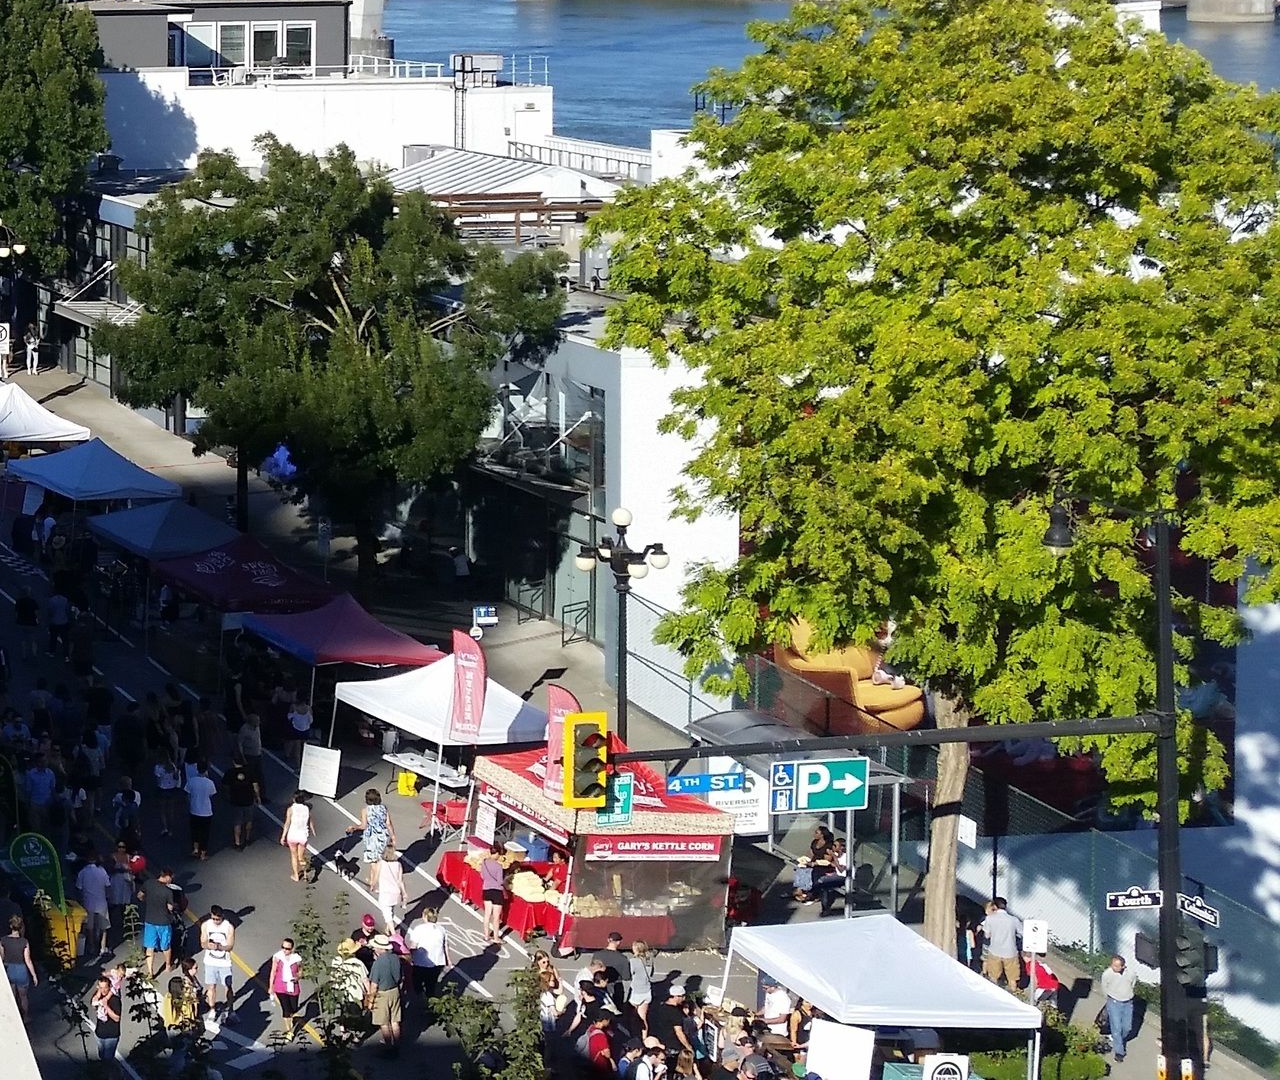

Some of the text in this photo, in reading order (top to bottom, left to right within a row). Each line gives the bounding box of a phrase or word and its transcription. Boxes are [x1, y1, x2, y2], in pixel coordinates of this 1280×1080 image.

[668, 775, 743, 792] 4TH ST.
[797, 764, 831, 809] P
[715, 798, 760, 806] RIVERSIDE
[617, 842, 715, 851] GARY'S KETTLE CORN
[1117, 895, 1152, 907] Fourth
